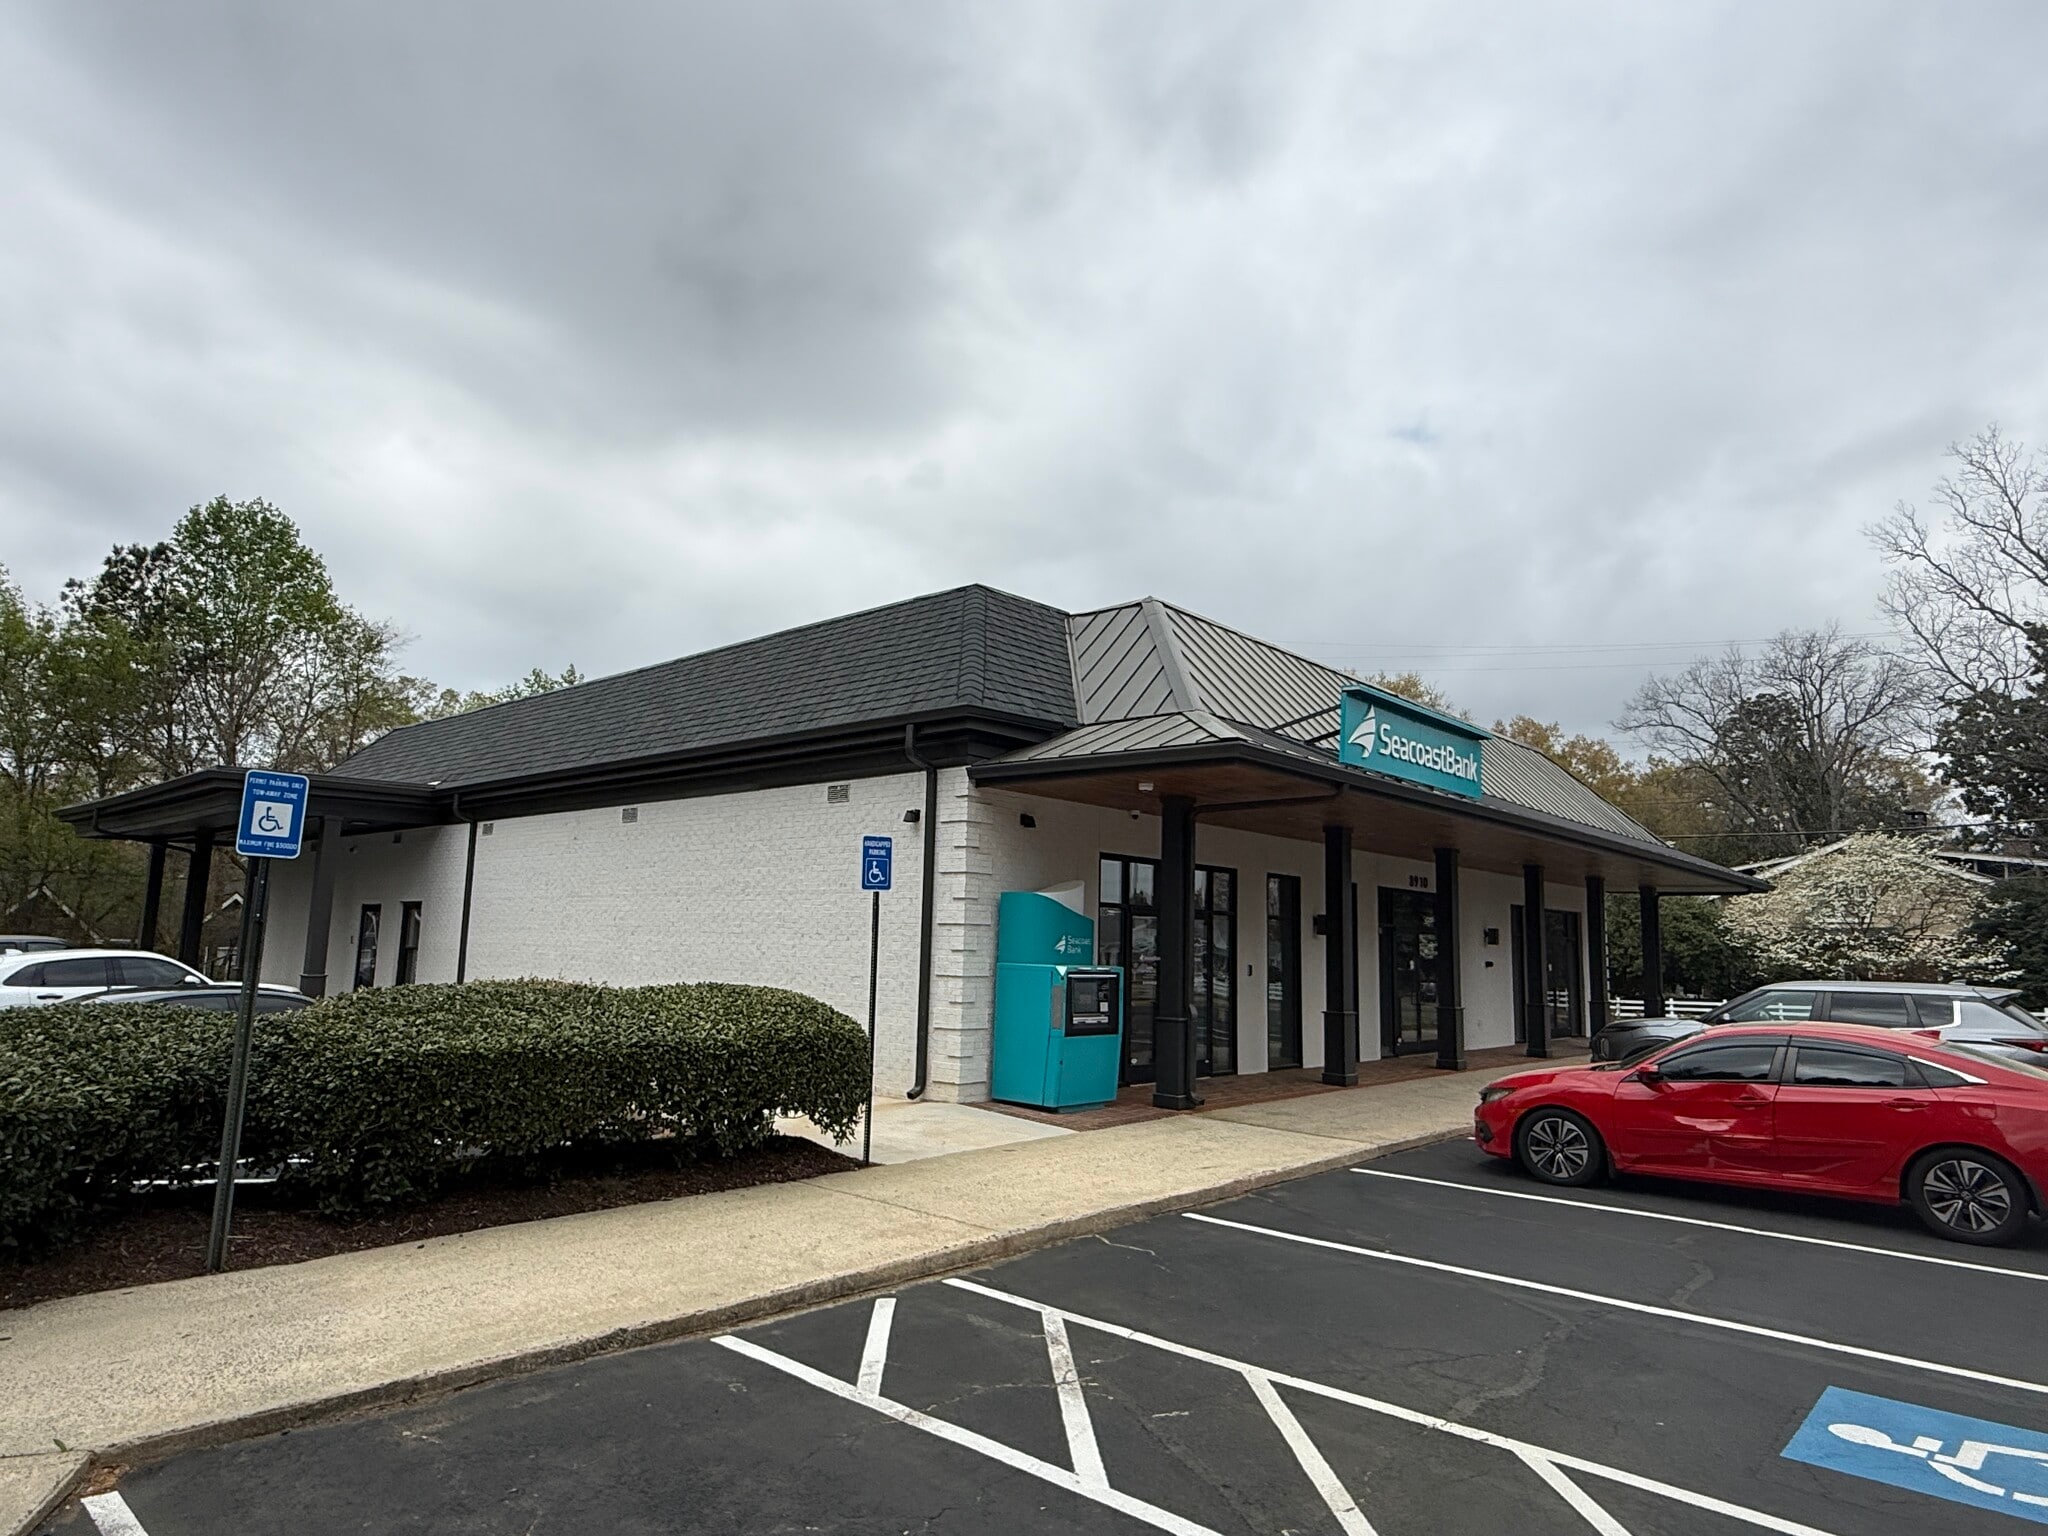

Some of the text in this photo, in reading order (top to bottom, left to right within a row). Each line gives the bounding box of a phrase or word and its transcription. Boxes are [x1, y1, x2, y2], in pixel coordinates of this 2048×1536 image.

[1380, 723, 1478, 782] SeacoastBank
[269, 780, 289, 788] PARKING
[252, 789, 298, 800] TOW-AWAY ZONE
